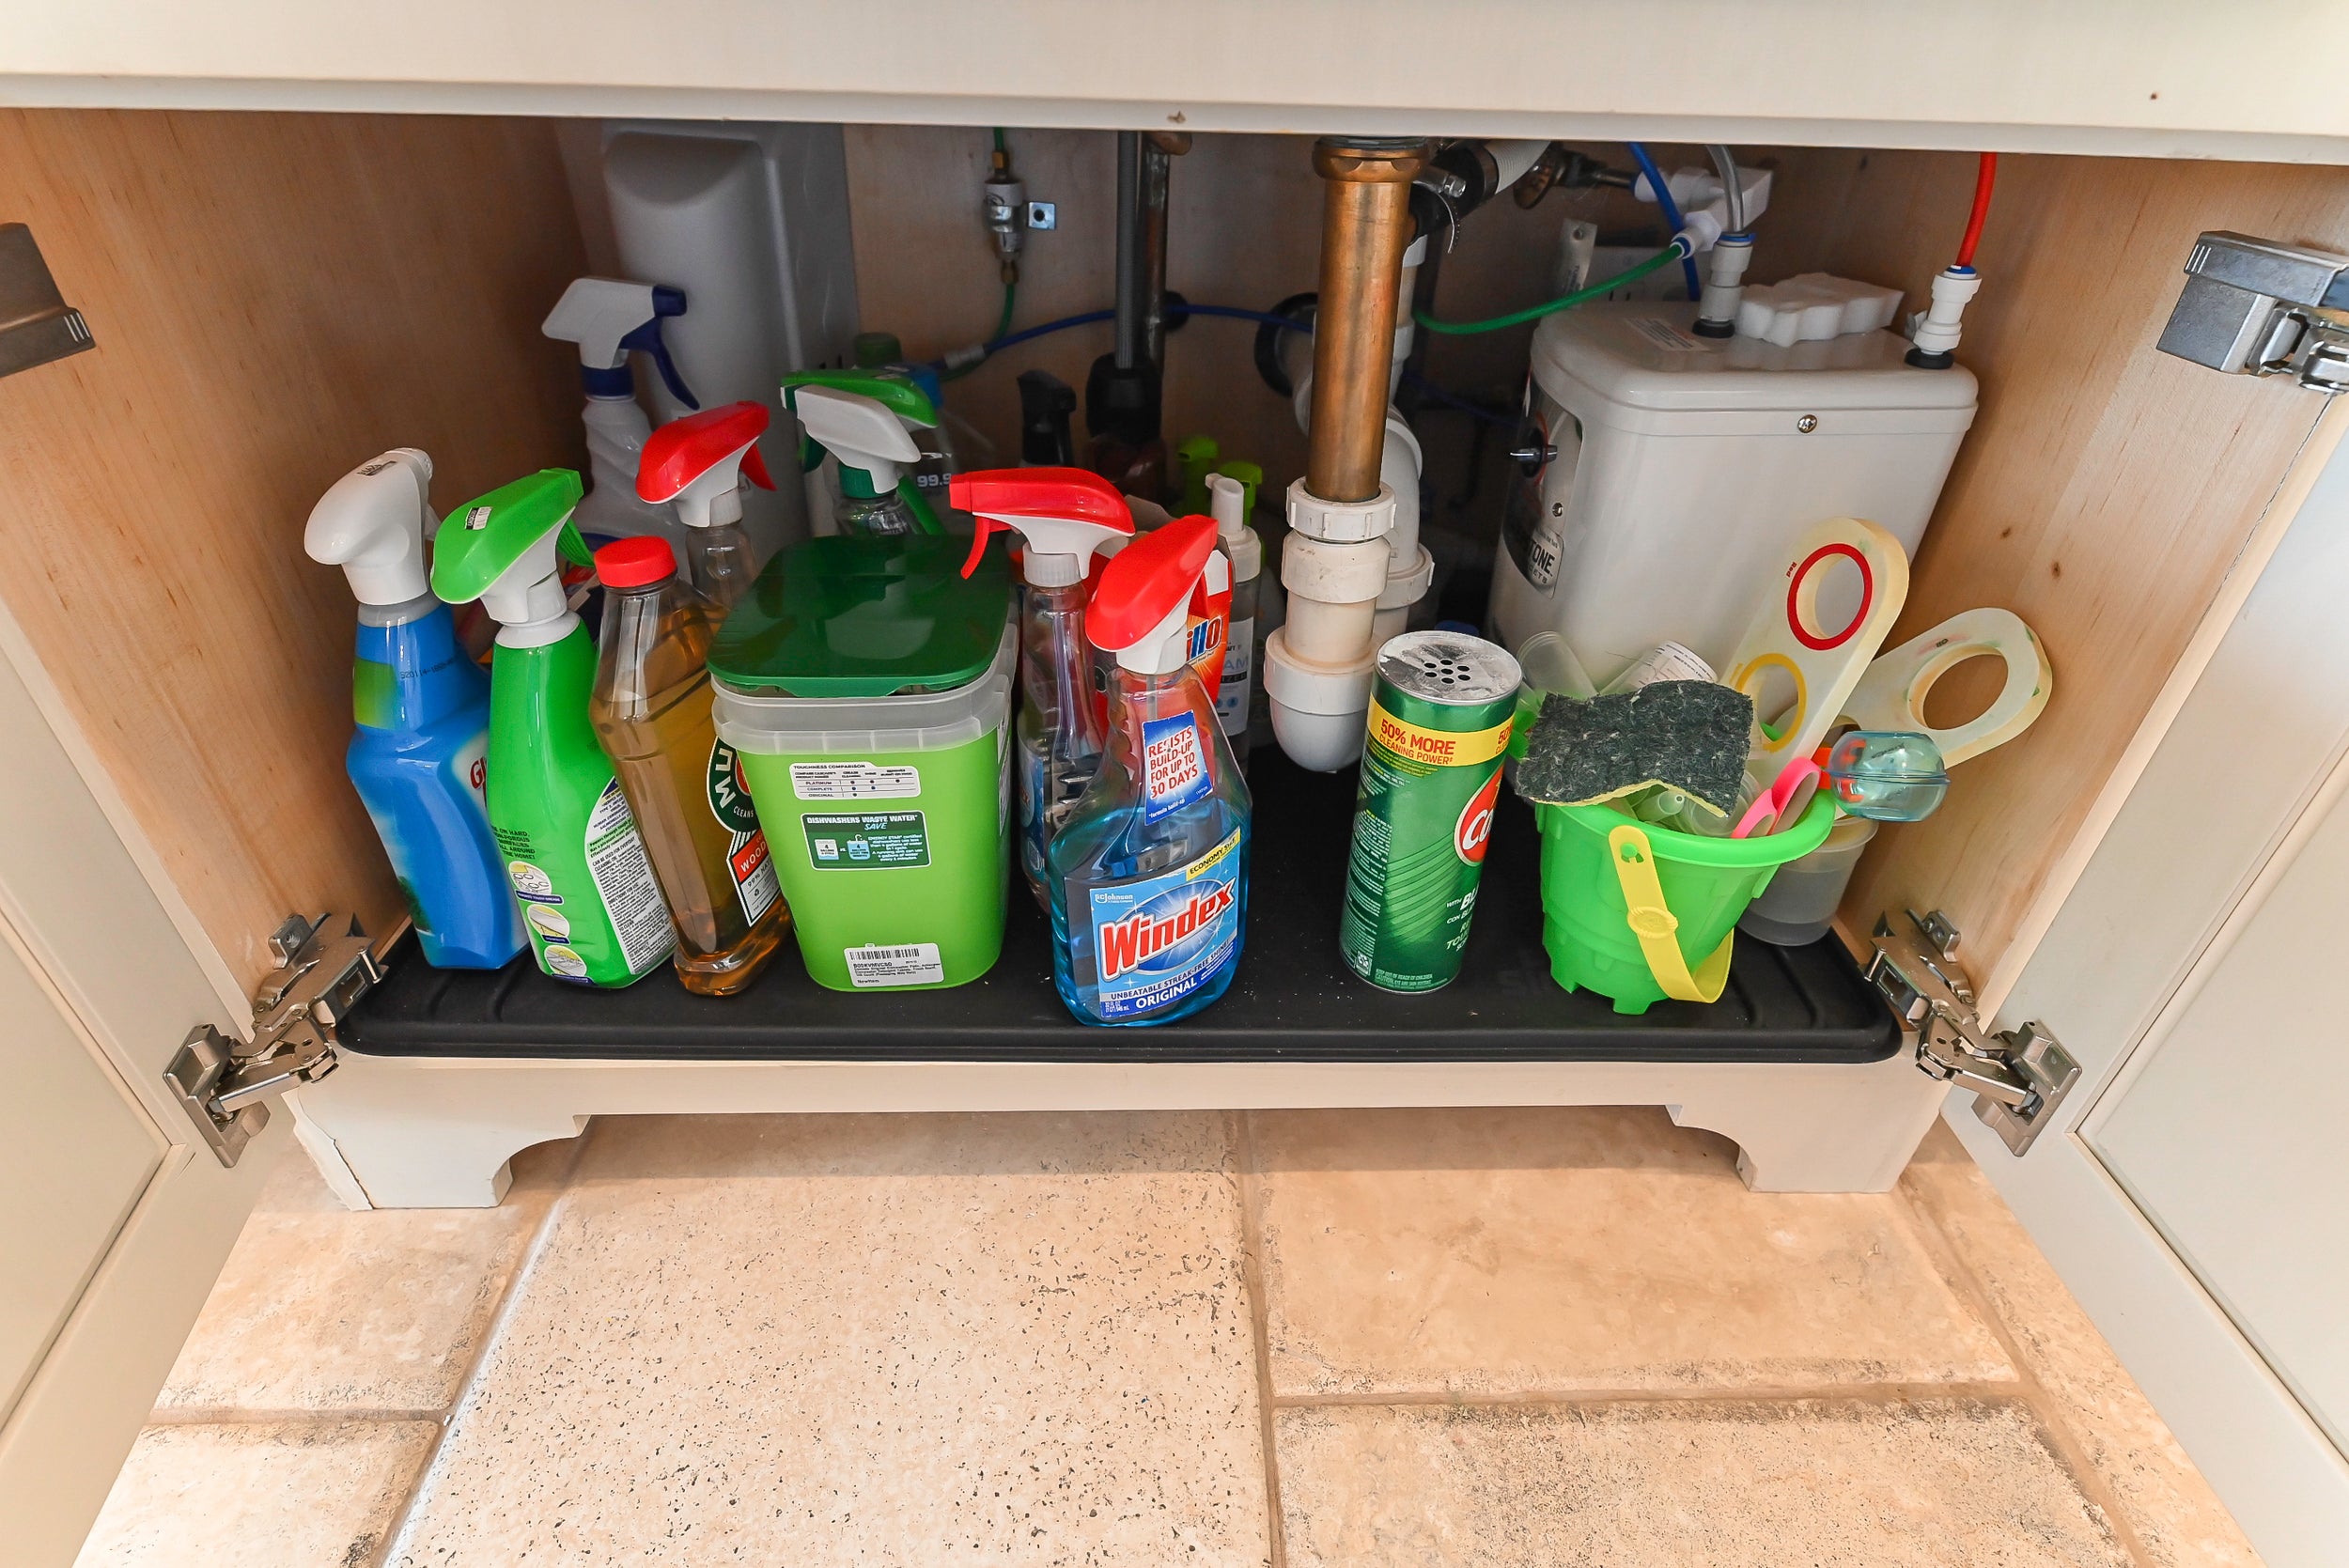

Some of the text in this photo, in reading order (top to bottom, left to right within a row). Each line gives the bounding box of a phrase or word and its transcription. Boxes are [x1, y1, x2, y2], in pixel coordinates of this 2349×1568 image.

[916, 473, 952, 488] 99.9
[1786, 562, 1797, 578] Red
[1187, 615, 1222, 661] illo
[1224, 657, 1249, 670] AM
[1379, 734, 1414, 759] CLEANING
[1380, 719, 1407, 745] 50%
[1410, 734, 1456, 755] MORE
[1151, 752, 1195, 784] FOR UP TO
[1151, 764, 1198, 799] 30 DAYS
[806, 815, 860, 824] DISHWASHERS
[863, 822, 888, 831] SAVE
[740, 841, 767, 873] WOOD
[1190, 848, 1223, 875] ECONOMY
[1103, 882, 1233, 976] Windex
[1111, 983, 1162, 1000] UNBEATABLE
[1163, 959, 1210, 986] STREAK-FREE
[1135, 978, 1197, 1009] ORIGINAL
